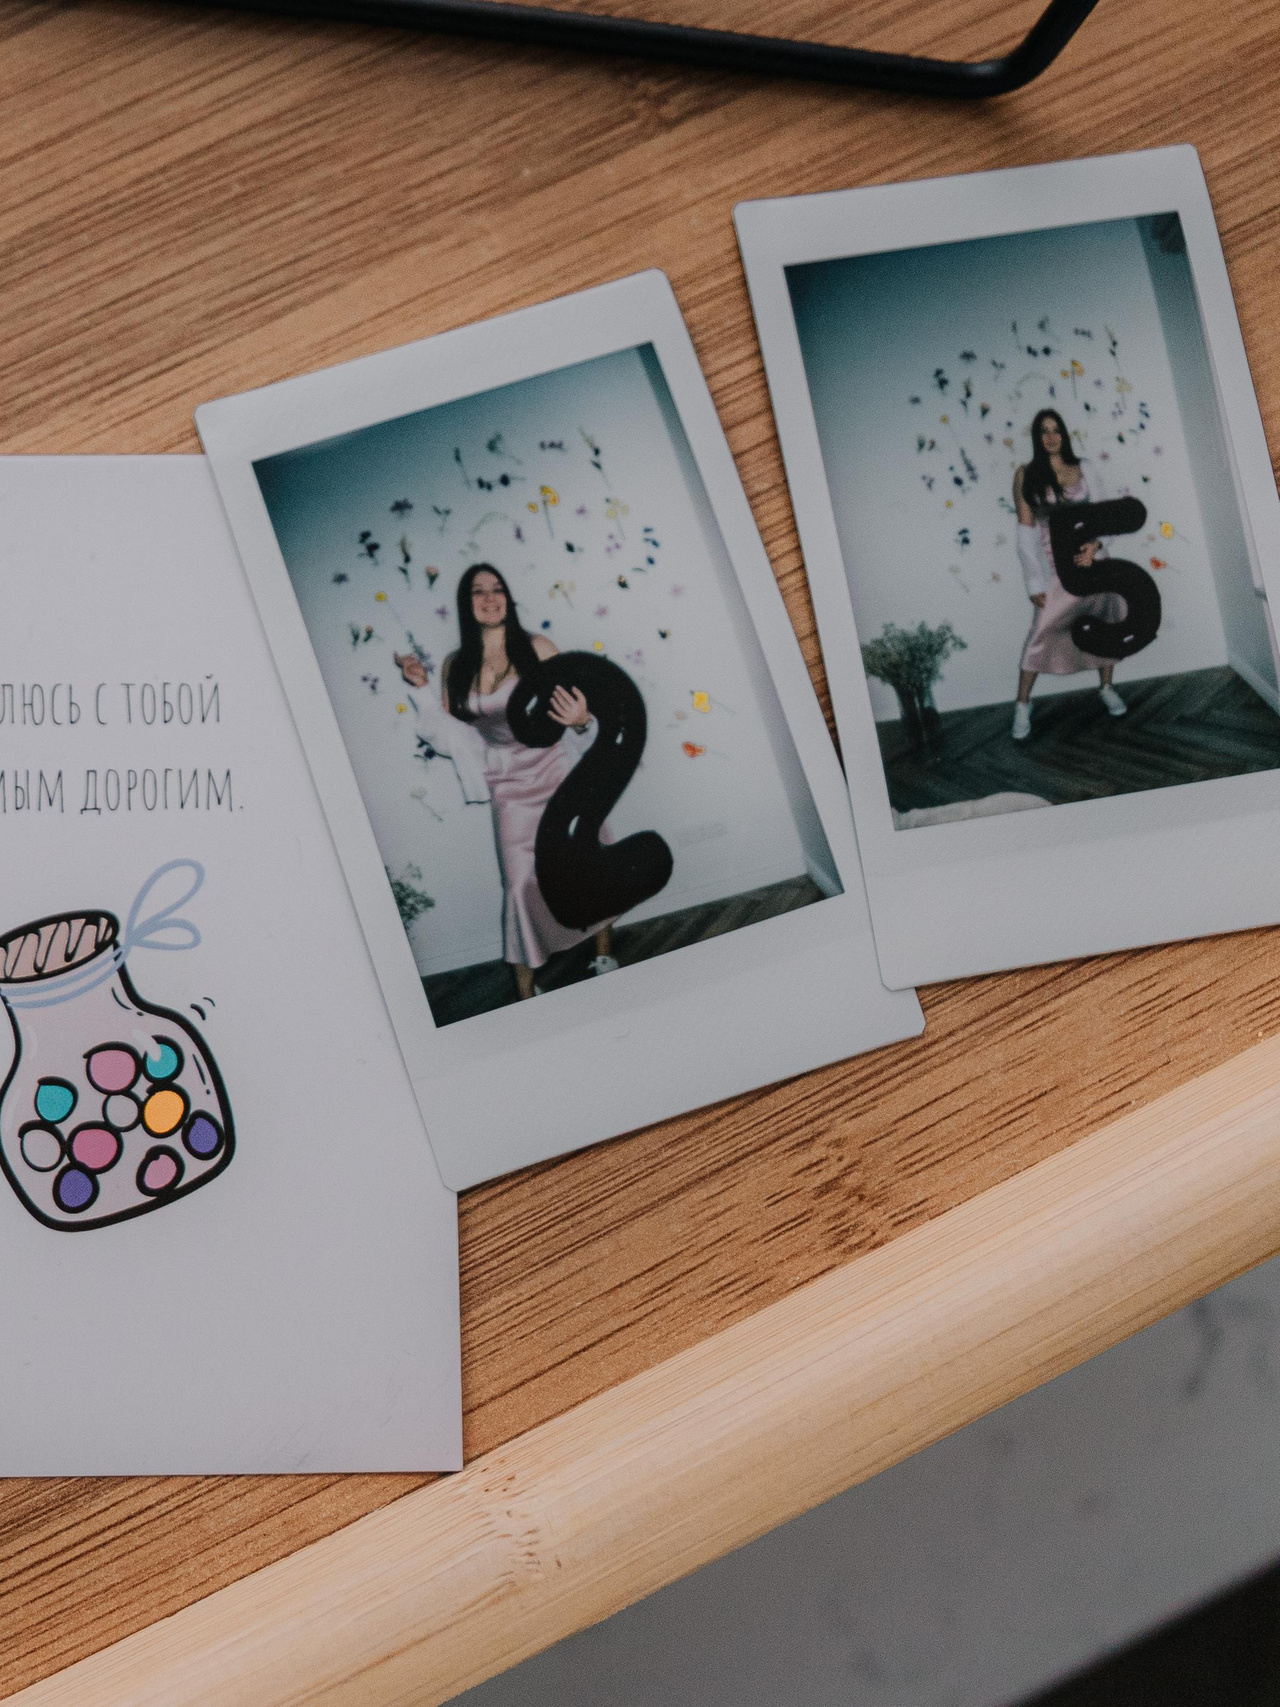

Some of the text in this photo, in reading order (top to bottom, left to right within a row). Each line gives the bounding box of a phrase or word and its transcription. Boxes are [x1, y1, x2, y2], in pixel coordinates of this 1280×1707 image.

[1049, 495, 1162, 661] 5
[120, 673, 221, 726] ТОБОЙ
[79, 767, 245, 816] ДОРОГИМ.
[506, 650, 674, 932] 2
